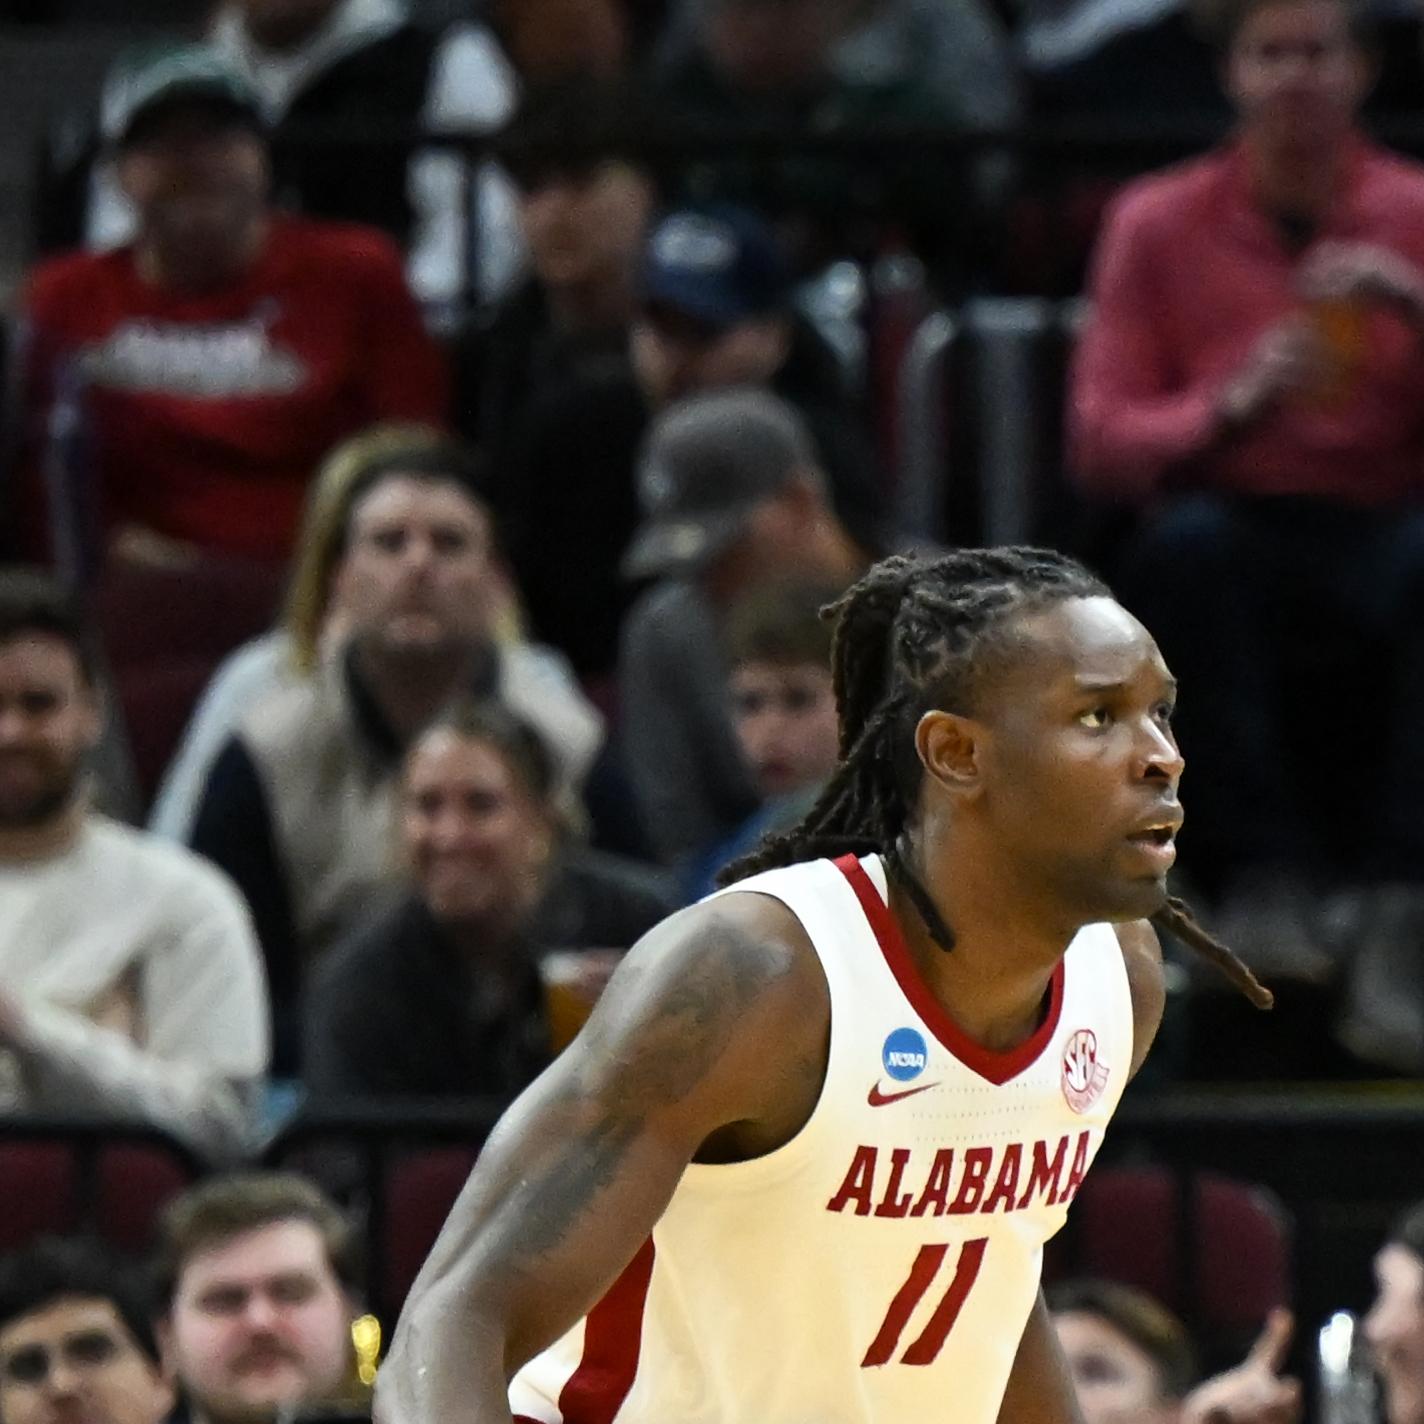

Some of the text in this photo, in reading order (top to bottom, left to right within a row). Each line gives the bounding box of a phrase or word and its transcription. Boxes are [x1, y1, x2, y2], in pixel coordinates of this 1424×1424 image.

[888, 1051, 925, 1067] NCAA
[826, 1130, 1090, 1218] ALABAMA
[860, 1237, 989, 1368] 11
